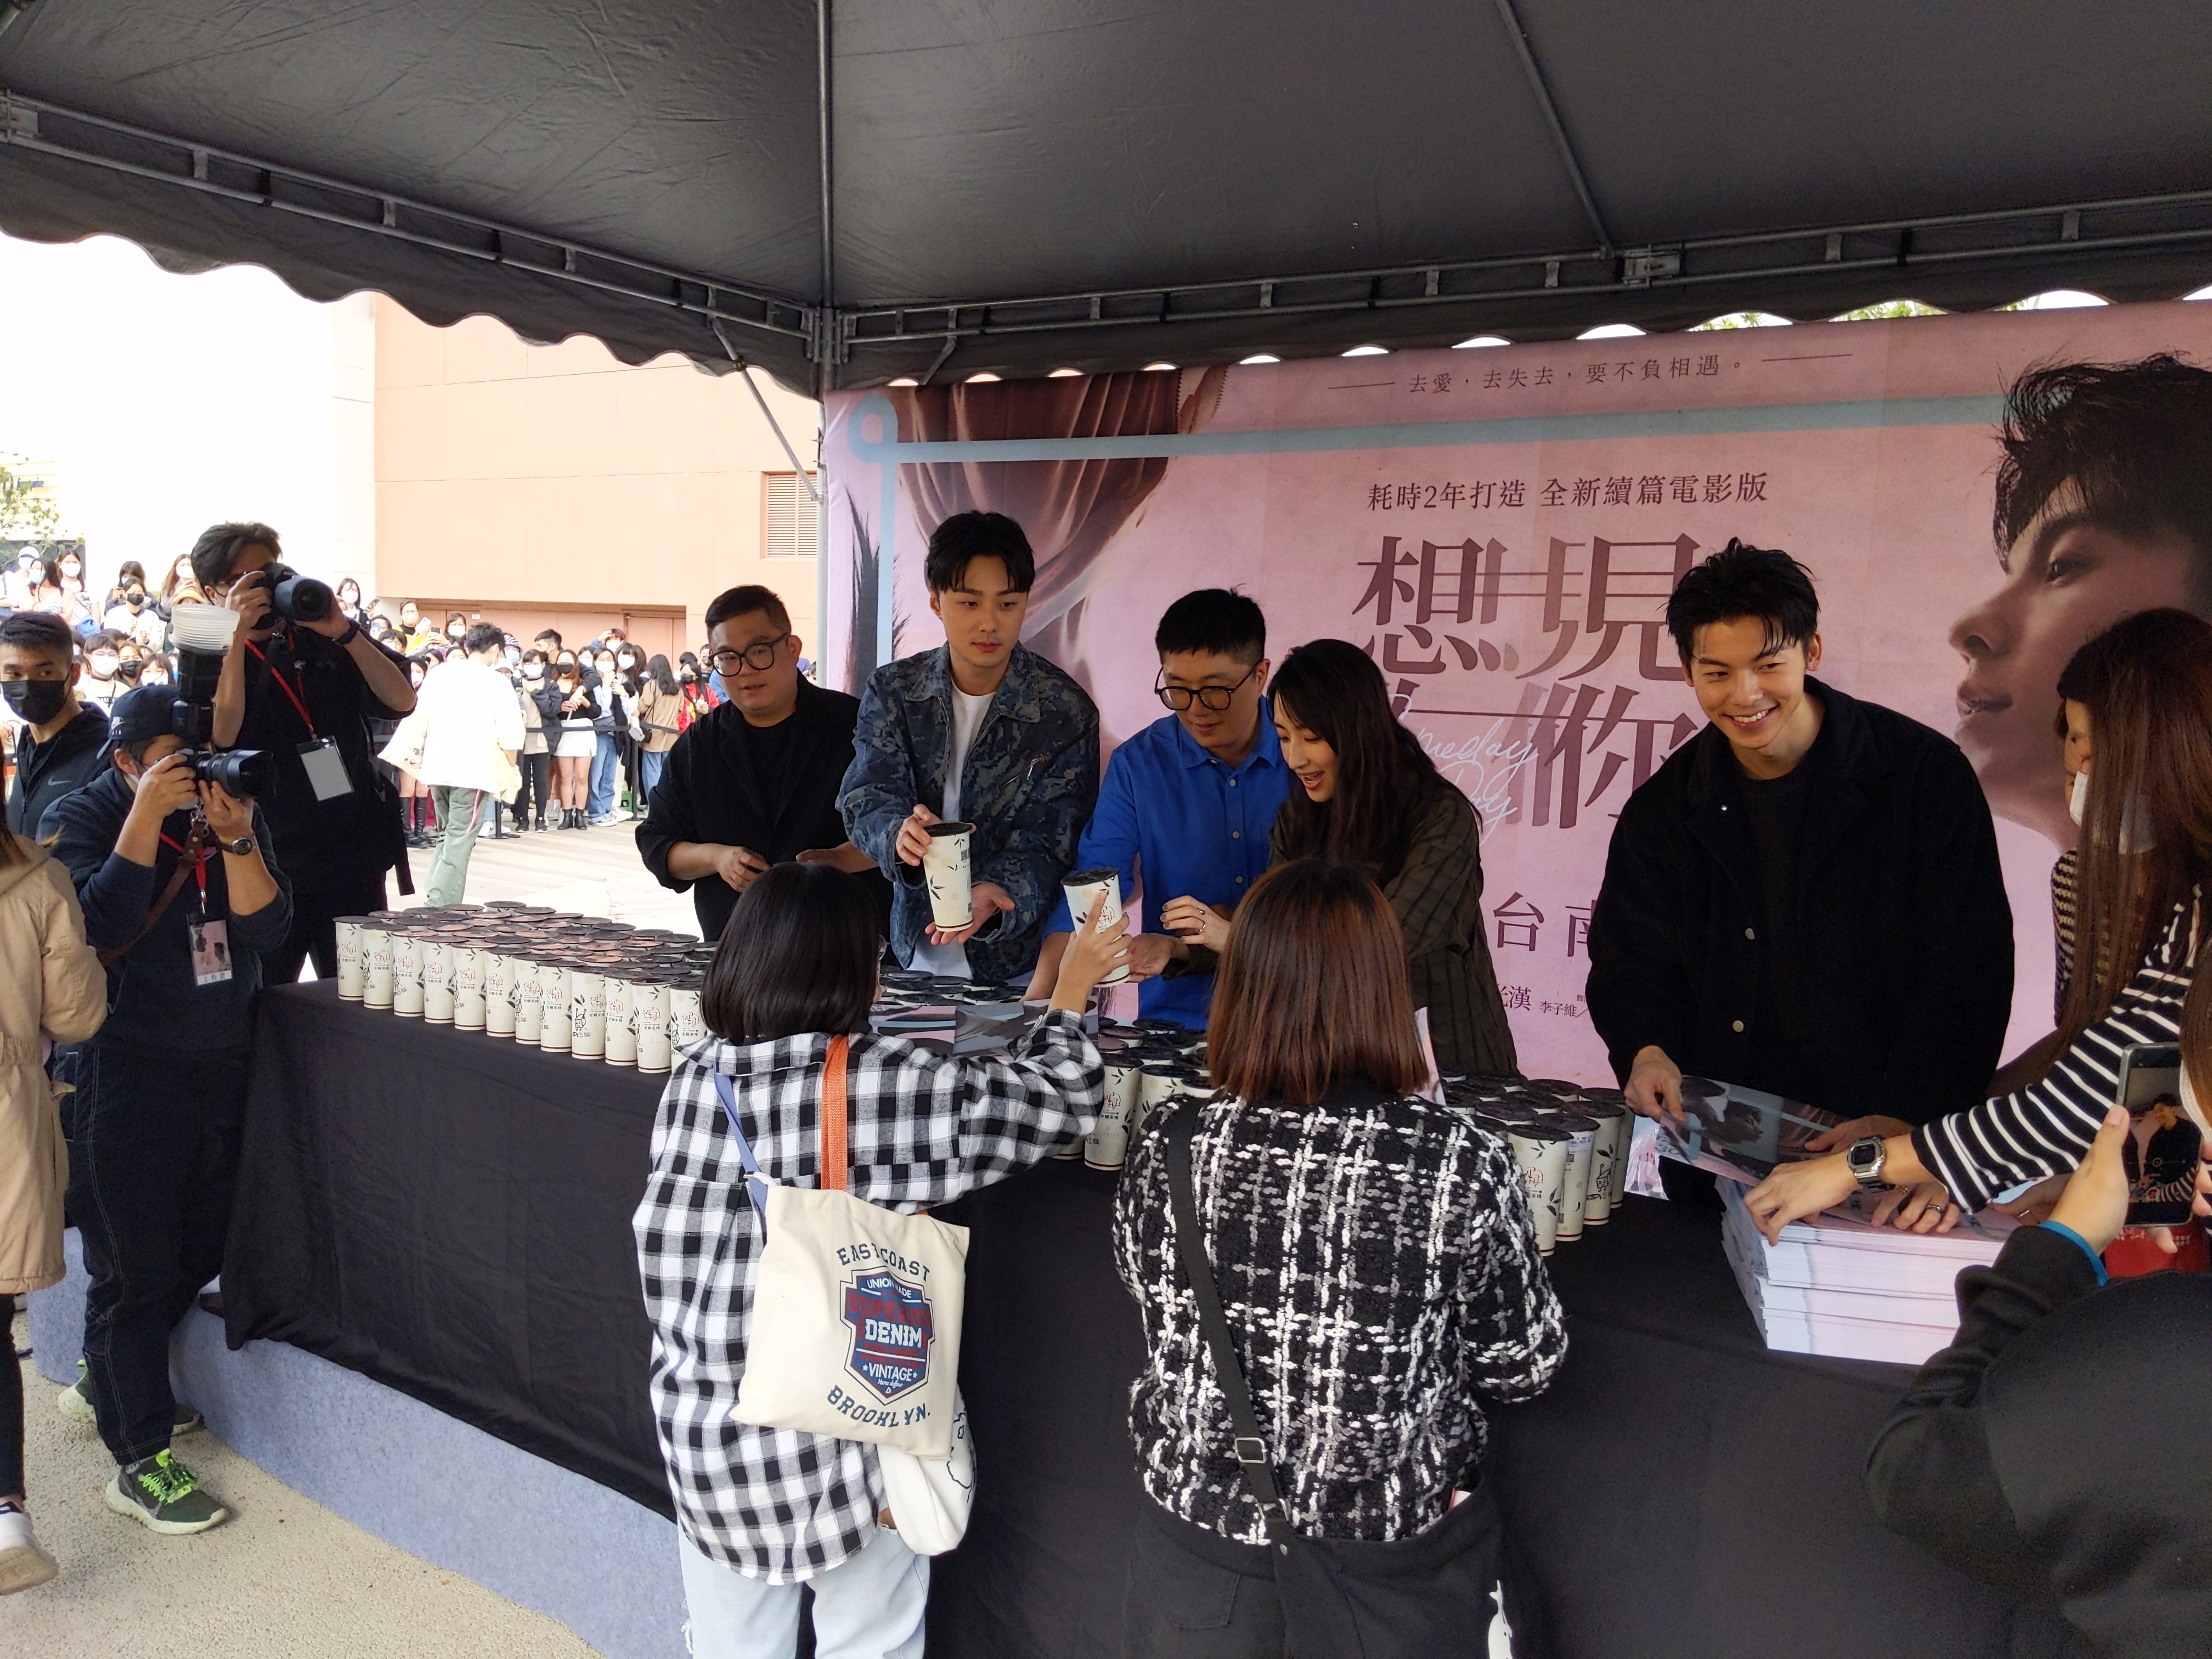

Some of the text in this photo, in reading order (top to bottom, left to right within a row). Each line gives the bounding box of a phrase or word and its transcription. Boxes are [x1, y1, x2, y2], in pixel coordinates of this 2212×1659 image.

[1367, 471, 1767, 511] 耗時2年打造 全新續篇電影版
[881, 1248, 930, 1282] COAST
[867, 1278, 895, 1289] UNION
[865, 1318, 922, 1348] DENIM
[868, 1362, 912, 1381] VINTAGE
